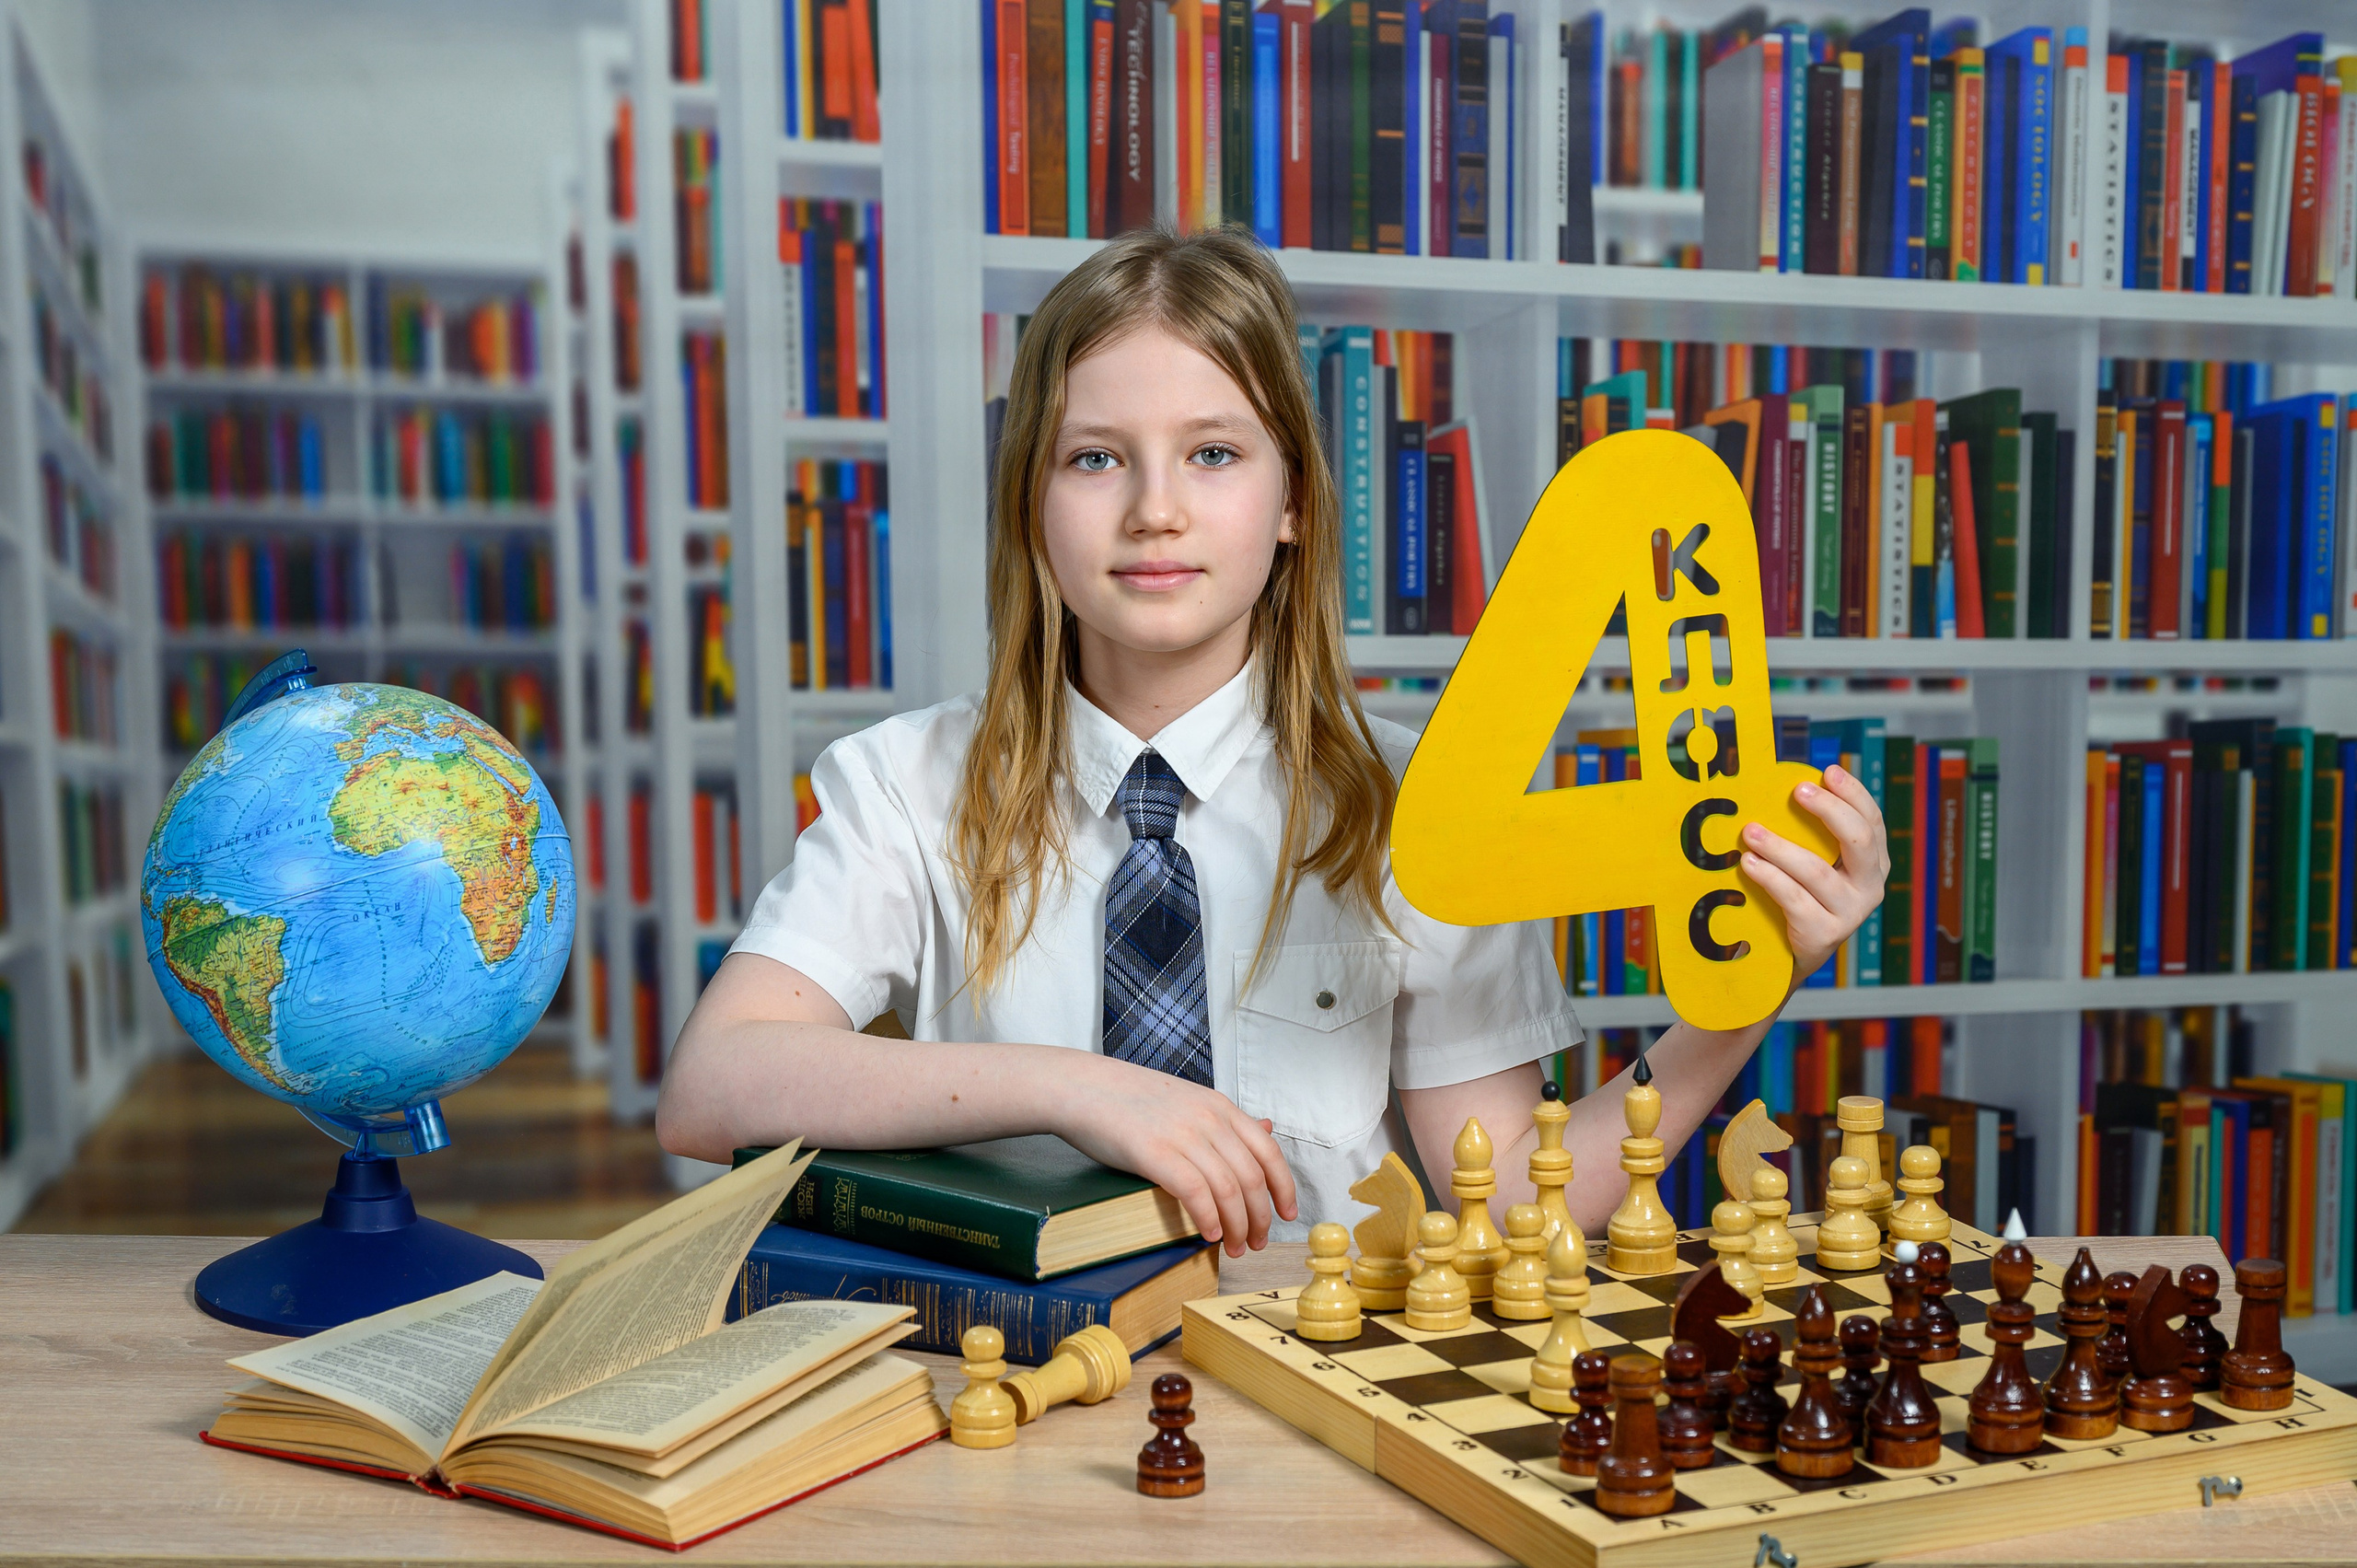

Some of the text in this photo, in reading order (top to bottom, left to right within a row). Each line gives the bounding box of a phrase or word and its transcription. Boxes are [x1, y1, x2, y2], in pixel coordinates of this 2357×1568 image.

[1126, 28, 1141, 182] TECHNOLOGY
[1791, 66, 1805, 255] CONSTRUCTION
[2104, 99, 2120, 282] STATISTICS
[1354, 376, 1368, 601] CONSTRUCTION
[1821, 442, 1838, 515] HISTORY
[1891, 463, 1906, 628] STATISTICS
[1389, 428, 1841, 1032] 4
[1979, 791, 1995, 861] HISTORY
[353, 902, 401, 923] ОКЕАН
[796, 1175, 807, 1220] ЖЮЛЬ
[806, 1181, 816, 1216] ВЕРН
[860, 1205, 1001, 1249] ТАИНСТВЕННЫЙ ОСТРОВ
[1225, 1312, 1580, 1510] 8 7 6 5 4 3 2 1
[1660, 1417, 2309, 1530] A B C D E F G H
